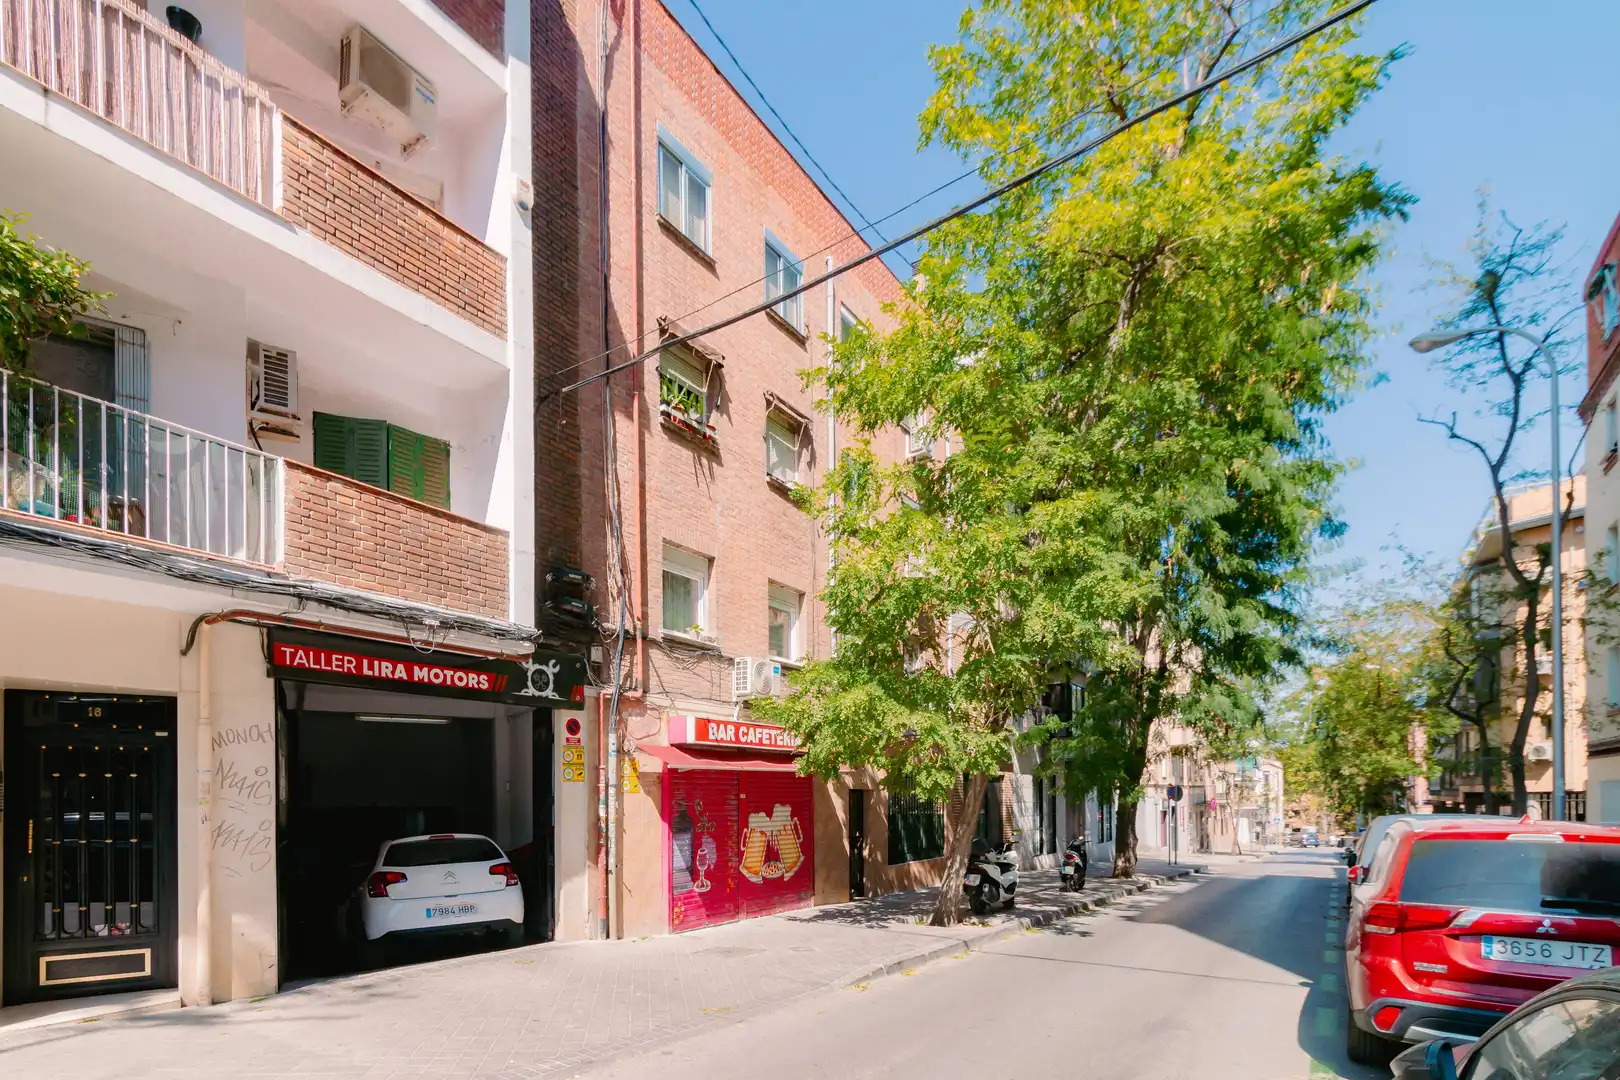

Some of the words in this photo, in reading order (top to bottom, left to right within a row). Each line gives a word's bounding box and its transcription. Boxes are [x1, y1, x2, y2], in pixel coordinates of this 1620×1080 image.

[281, 647, 356, 673] TALLER
[362, 658, 407, 680] LIRA
[413, 666, 489, 689] MOTORS
[88, 706, 102, 717] 16
[708, 722, 736, 741] BAR
[432, 907, 456, 916] 7984
[458, 905, 475, 913] HBP
[1497, 939, 1552, 958] 3656
[1562, 945, 1606, 963] JTZ
